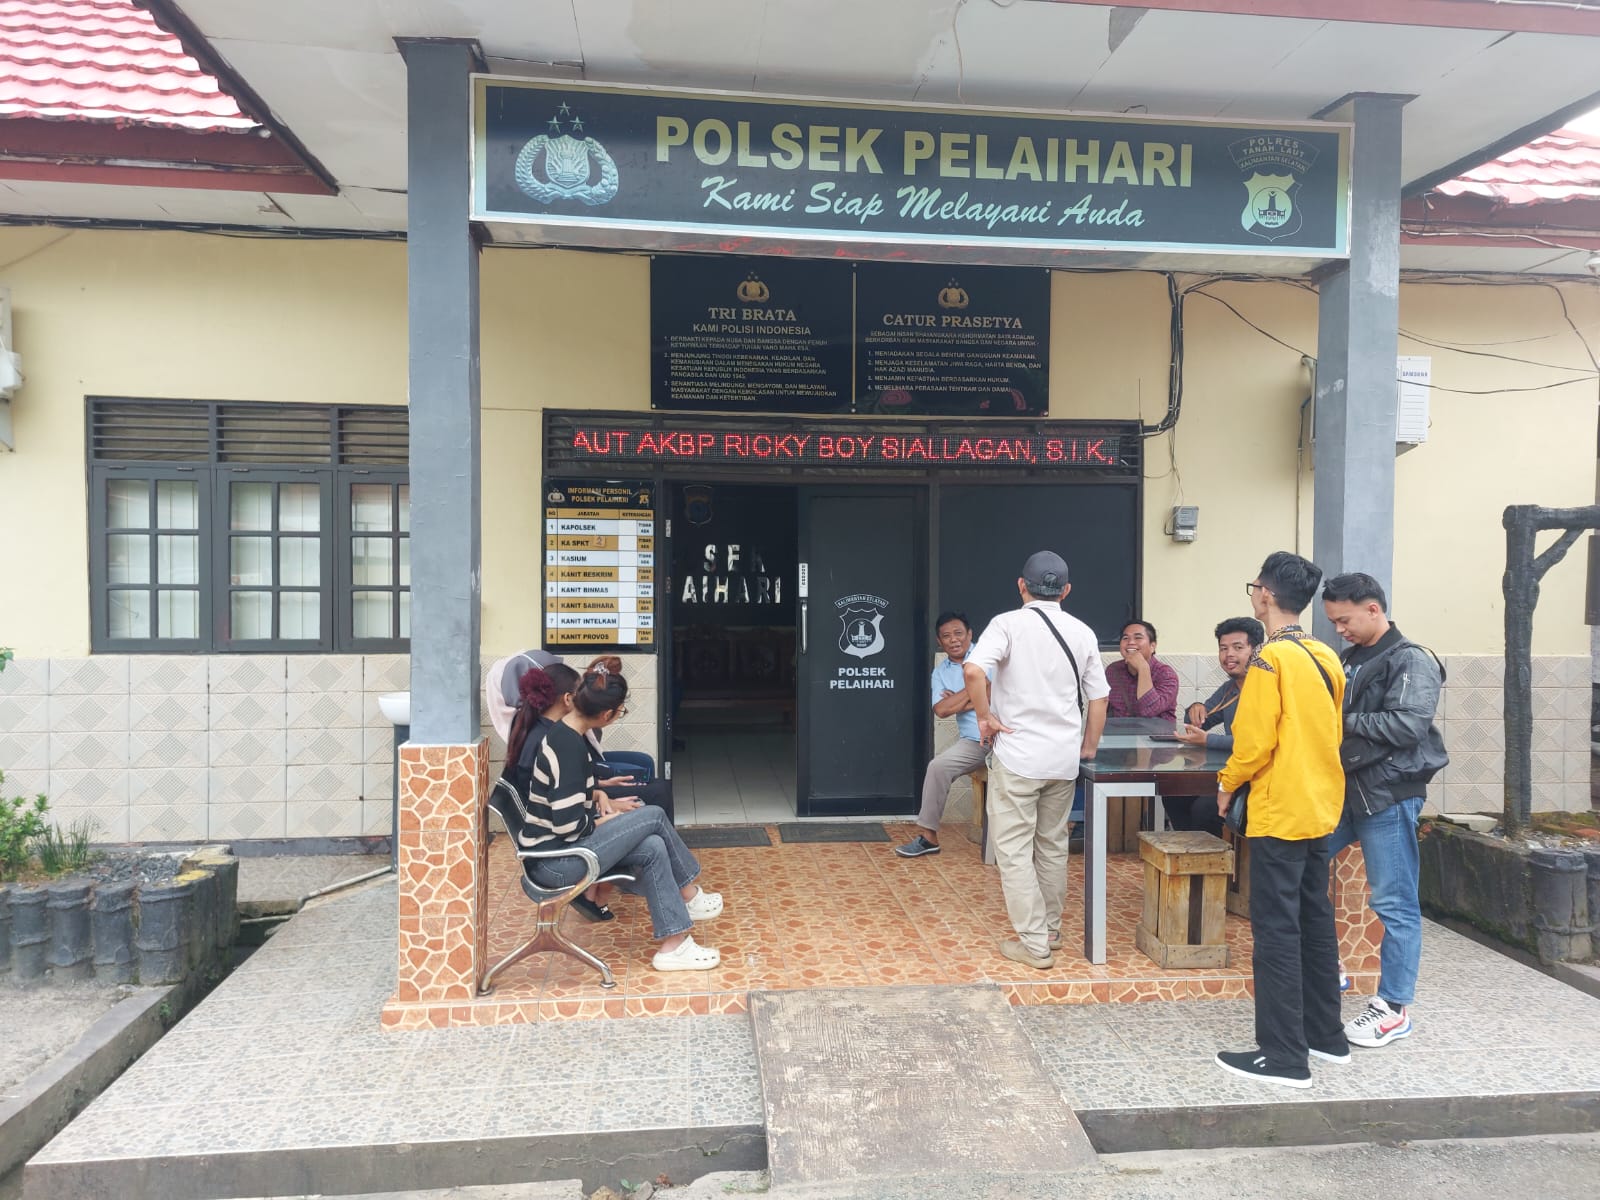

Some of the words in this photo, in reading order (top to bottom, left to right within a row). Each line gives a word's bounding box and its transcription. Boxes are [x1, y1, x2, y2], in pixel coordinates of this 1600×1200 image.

[1249, 137, 1298, 148] POLRES
[655, 115, 883, 174] POLSEK
[904, 129, 1194, 188] PELAIHARI
[1243, 146, 1274, 156] TANAH
[1280, 147, 1304, 157] LAUT
[1240, 156, 1280, 168] KALIMANTAN
[1281, 156, 1306, 172] SELATAN
[698, 174, 797, 213] Kami
[803, 179, 886, 224] Siap
[896, 184, 1053, 230] Melayani
[1058, 191, 1146, 229] Anda
[708, 308, 736, 320] TRI
[742, 308, 796, 321] BRATA
[883, 314, 936, 326] CATUR
[942, 316, 1022, 329] PRASETYA
[693, 324, 718, 333] KAMI
[722, 324, 754, 334] POLISI
[756, 325, 812, 335] INDONESIA
[574, 431, 627, 454] AUT
[636, 432, 715, 456] AKBP
[724, 434, 812, 458] RICKY
[818, 436, 876, 458] BOY
[882, 437, 1038, 464] SIALLAGAN,
[838, 667, 886, 676] POLSEK
[830, 679, 894, 689] PELAIHARI
